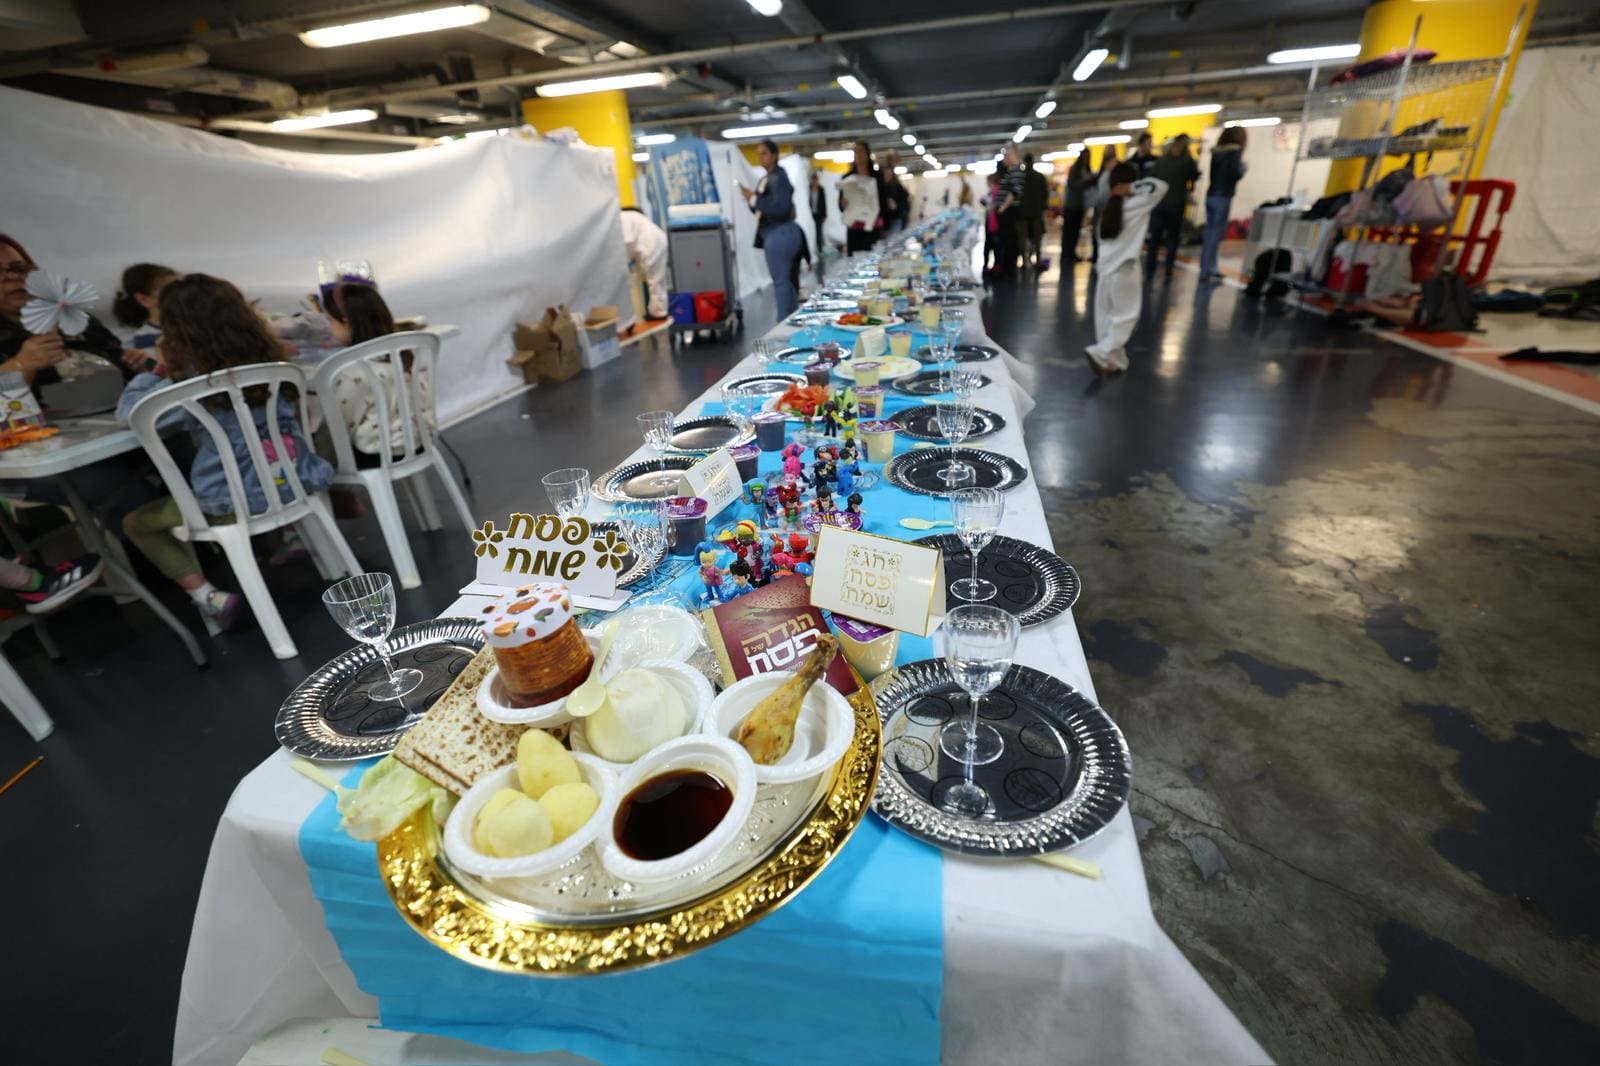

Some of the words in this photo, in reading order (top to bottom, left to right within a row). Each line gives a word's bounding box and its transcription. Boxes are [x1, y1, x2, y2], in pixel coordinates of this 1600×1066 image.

[506, 512, 591, 546] פסח
[504, 547, 587, 581] שמח
[860, 551, 885, 570] חג
[851, 568, 890, 590] פסח
[846, 586, 889, 608] שמח
[741, 613, 815, 656] הגדה
[751, 642, 764, 653] של
[747, 628, 821, 677] פסח
